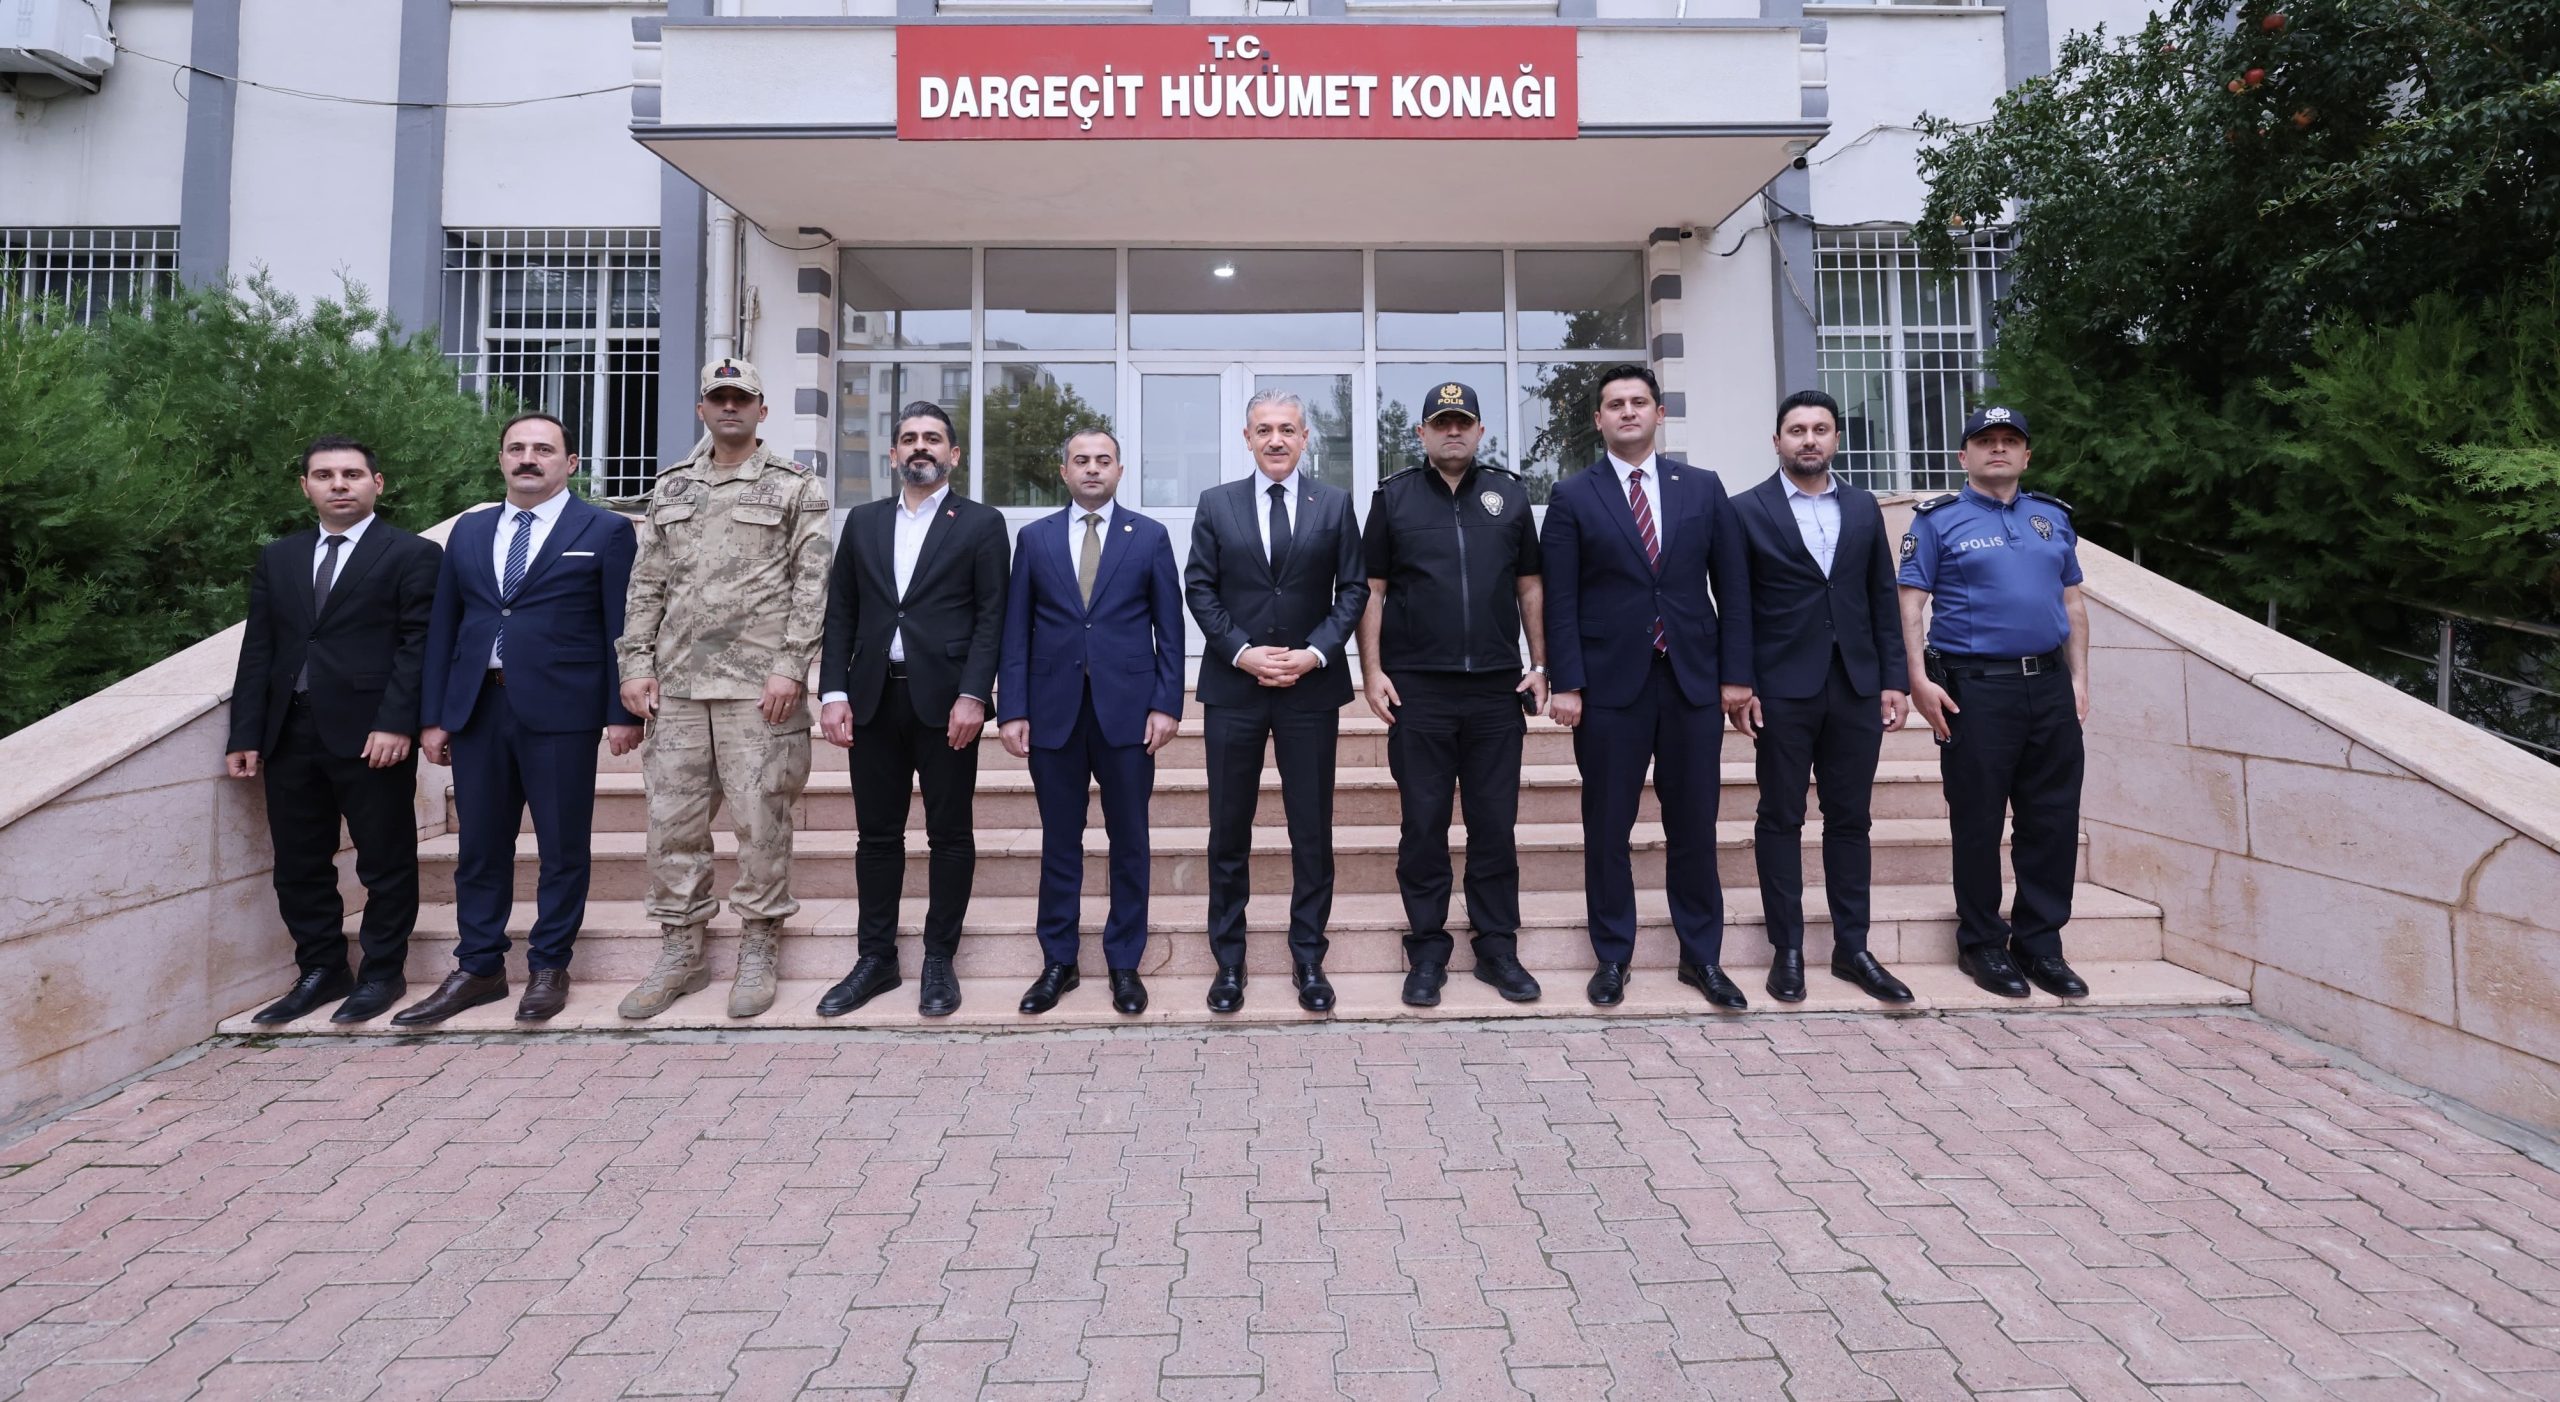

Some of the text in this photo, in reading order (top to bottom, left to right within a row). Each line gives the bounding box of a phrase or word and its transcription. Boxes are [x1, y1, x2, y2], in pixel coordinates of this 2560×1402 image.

[1208, 35, 1270, 59] T.C.
[920, 63, 1556, 130] DARGEÇİT HÜKÜMET KONAĞI
